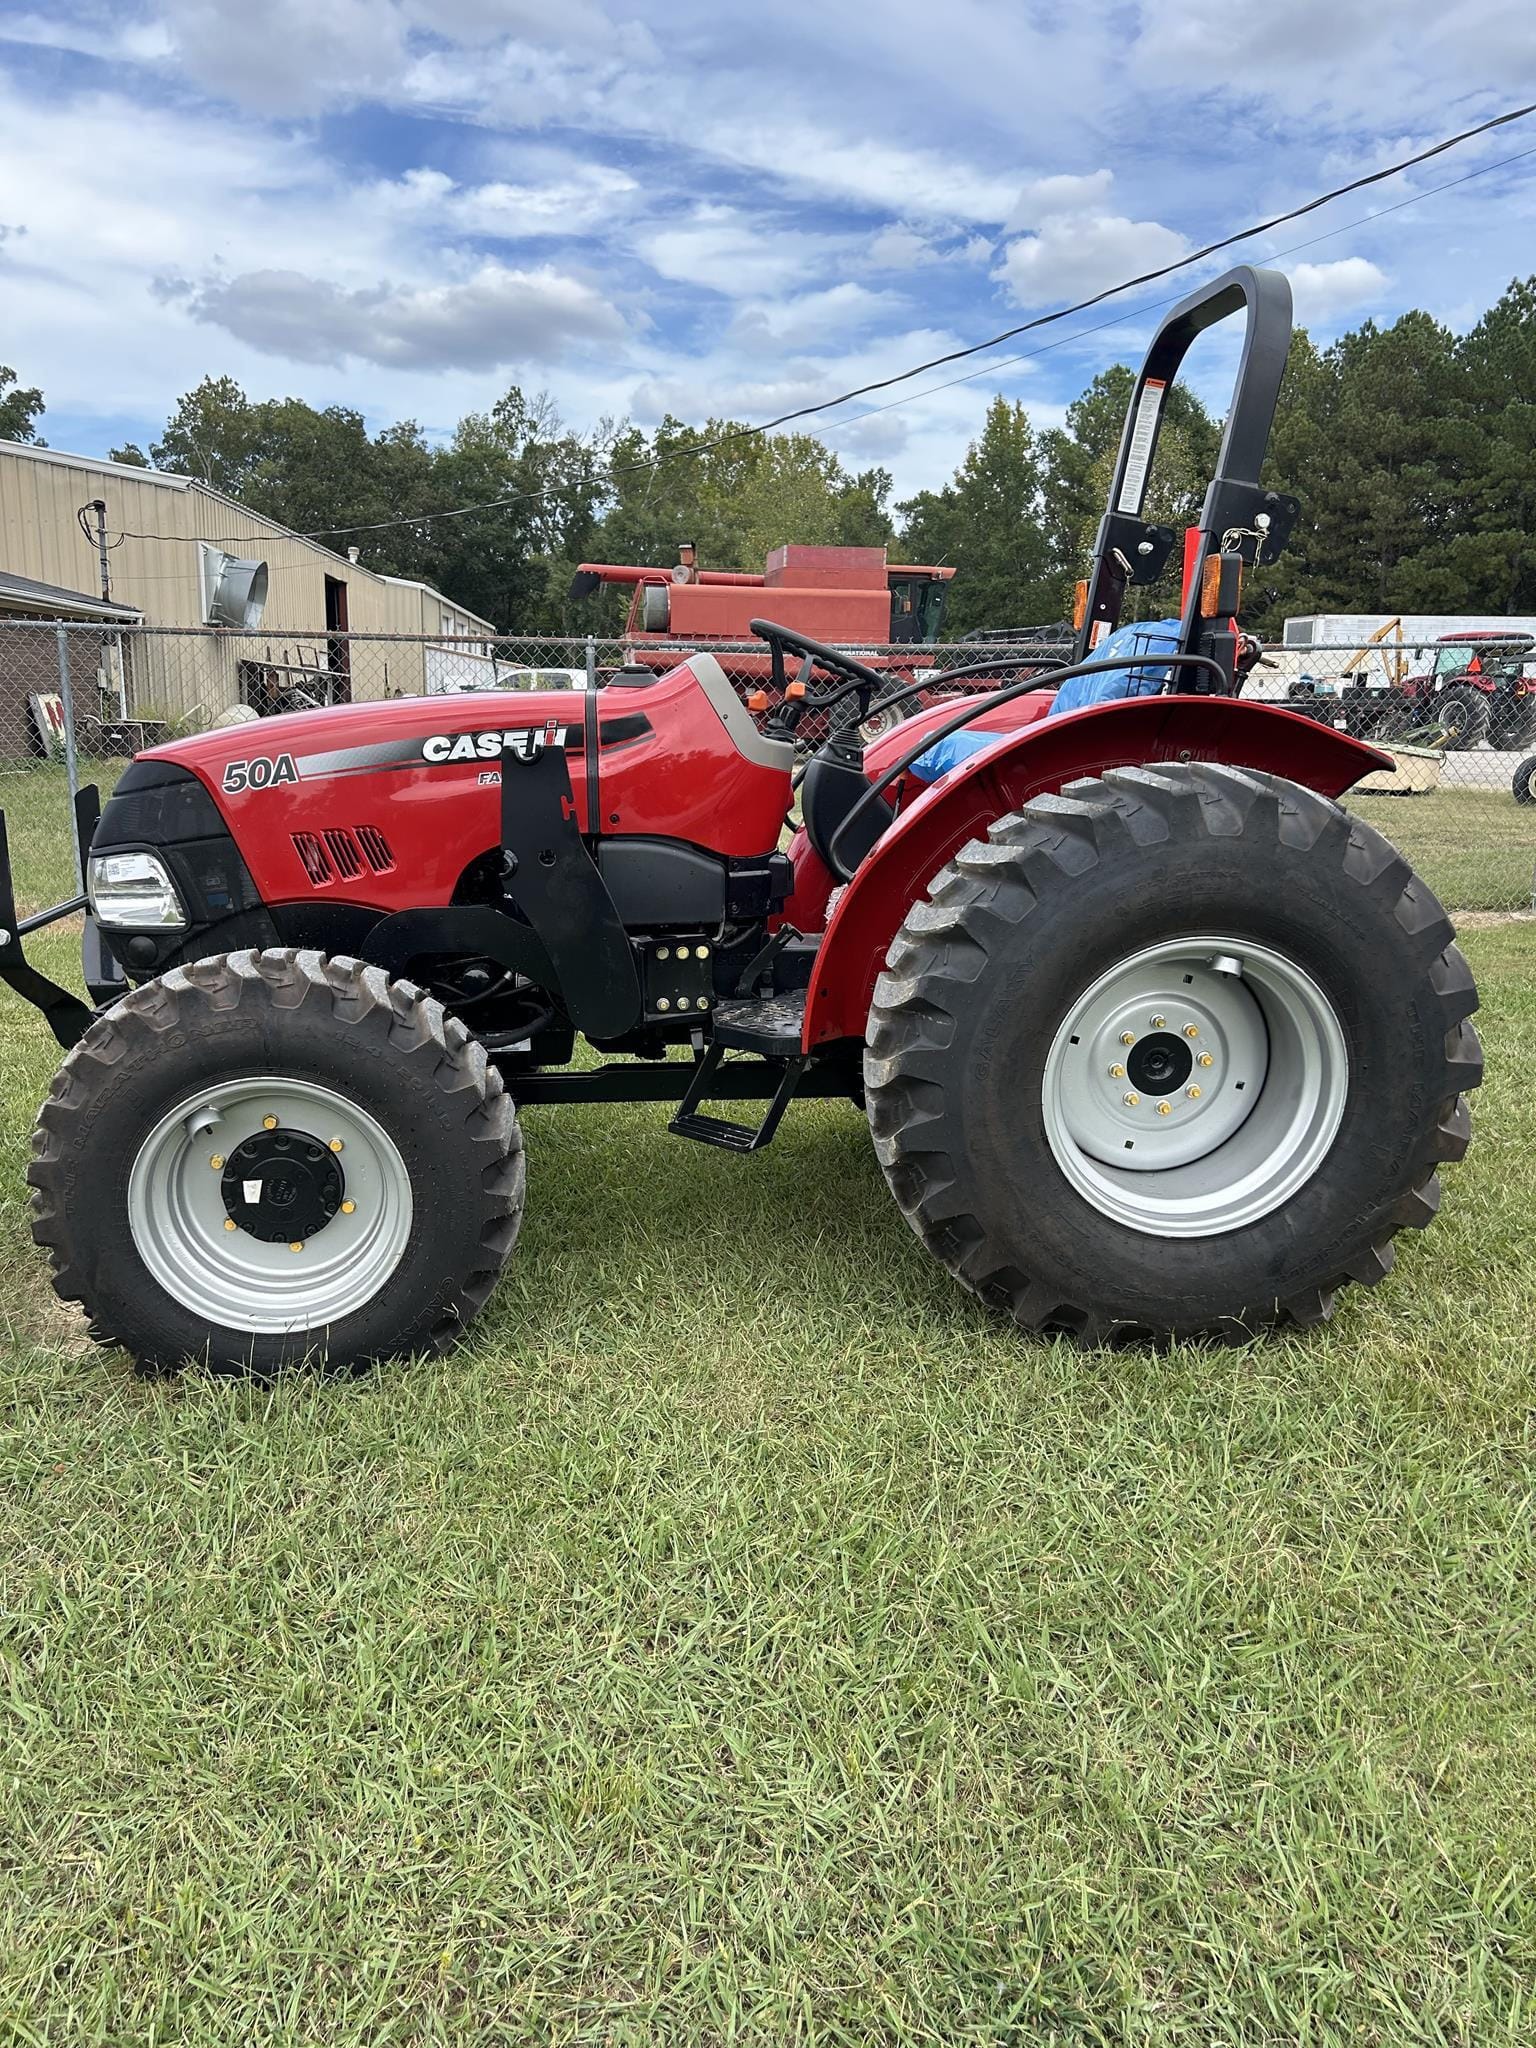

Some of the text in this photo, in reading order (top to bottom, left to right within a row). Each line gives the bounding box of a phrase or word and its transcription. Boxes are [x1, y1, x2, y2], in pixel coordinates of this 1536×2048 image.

[422, 731, 529, 762] CASE
[222, 752, 300, 794] 50A
[73, 1018, 258, 1150] MARATHONER
